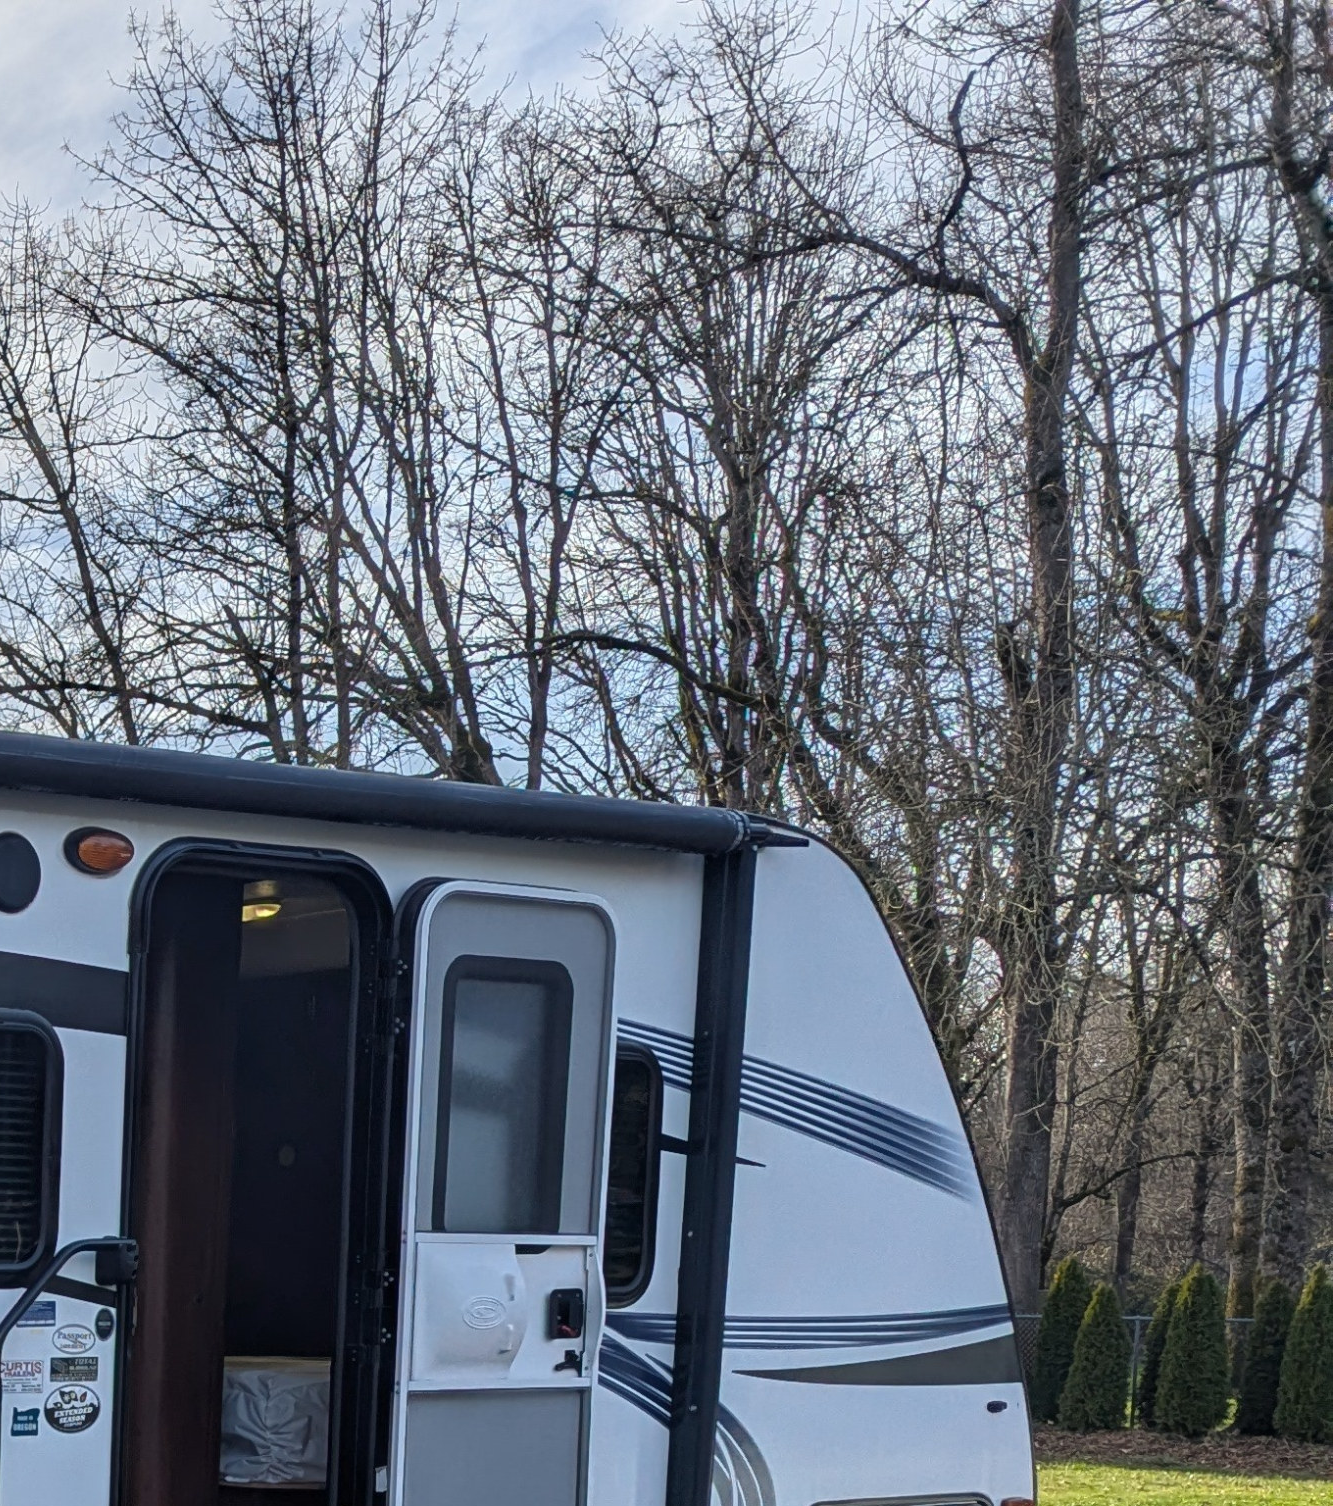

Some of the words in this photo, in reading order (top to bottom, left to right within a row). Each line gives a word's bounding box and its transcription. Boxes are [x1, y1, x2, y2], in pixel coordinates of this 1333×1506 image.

[0, 1361, 42, 1374] CURTIS
[54, 1406, 93, 1418] EXTENDED
[58, 1414, 85, 1424] SEASON
